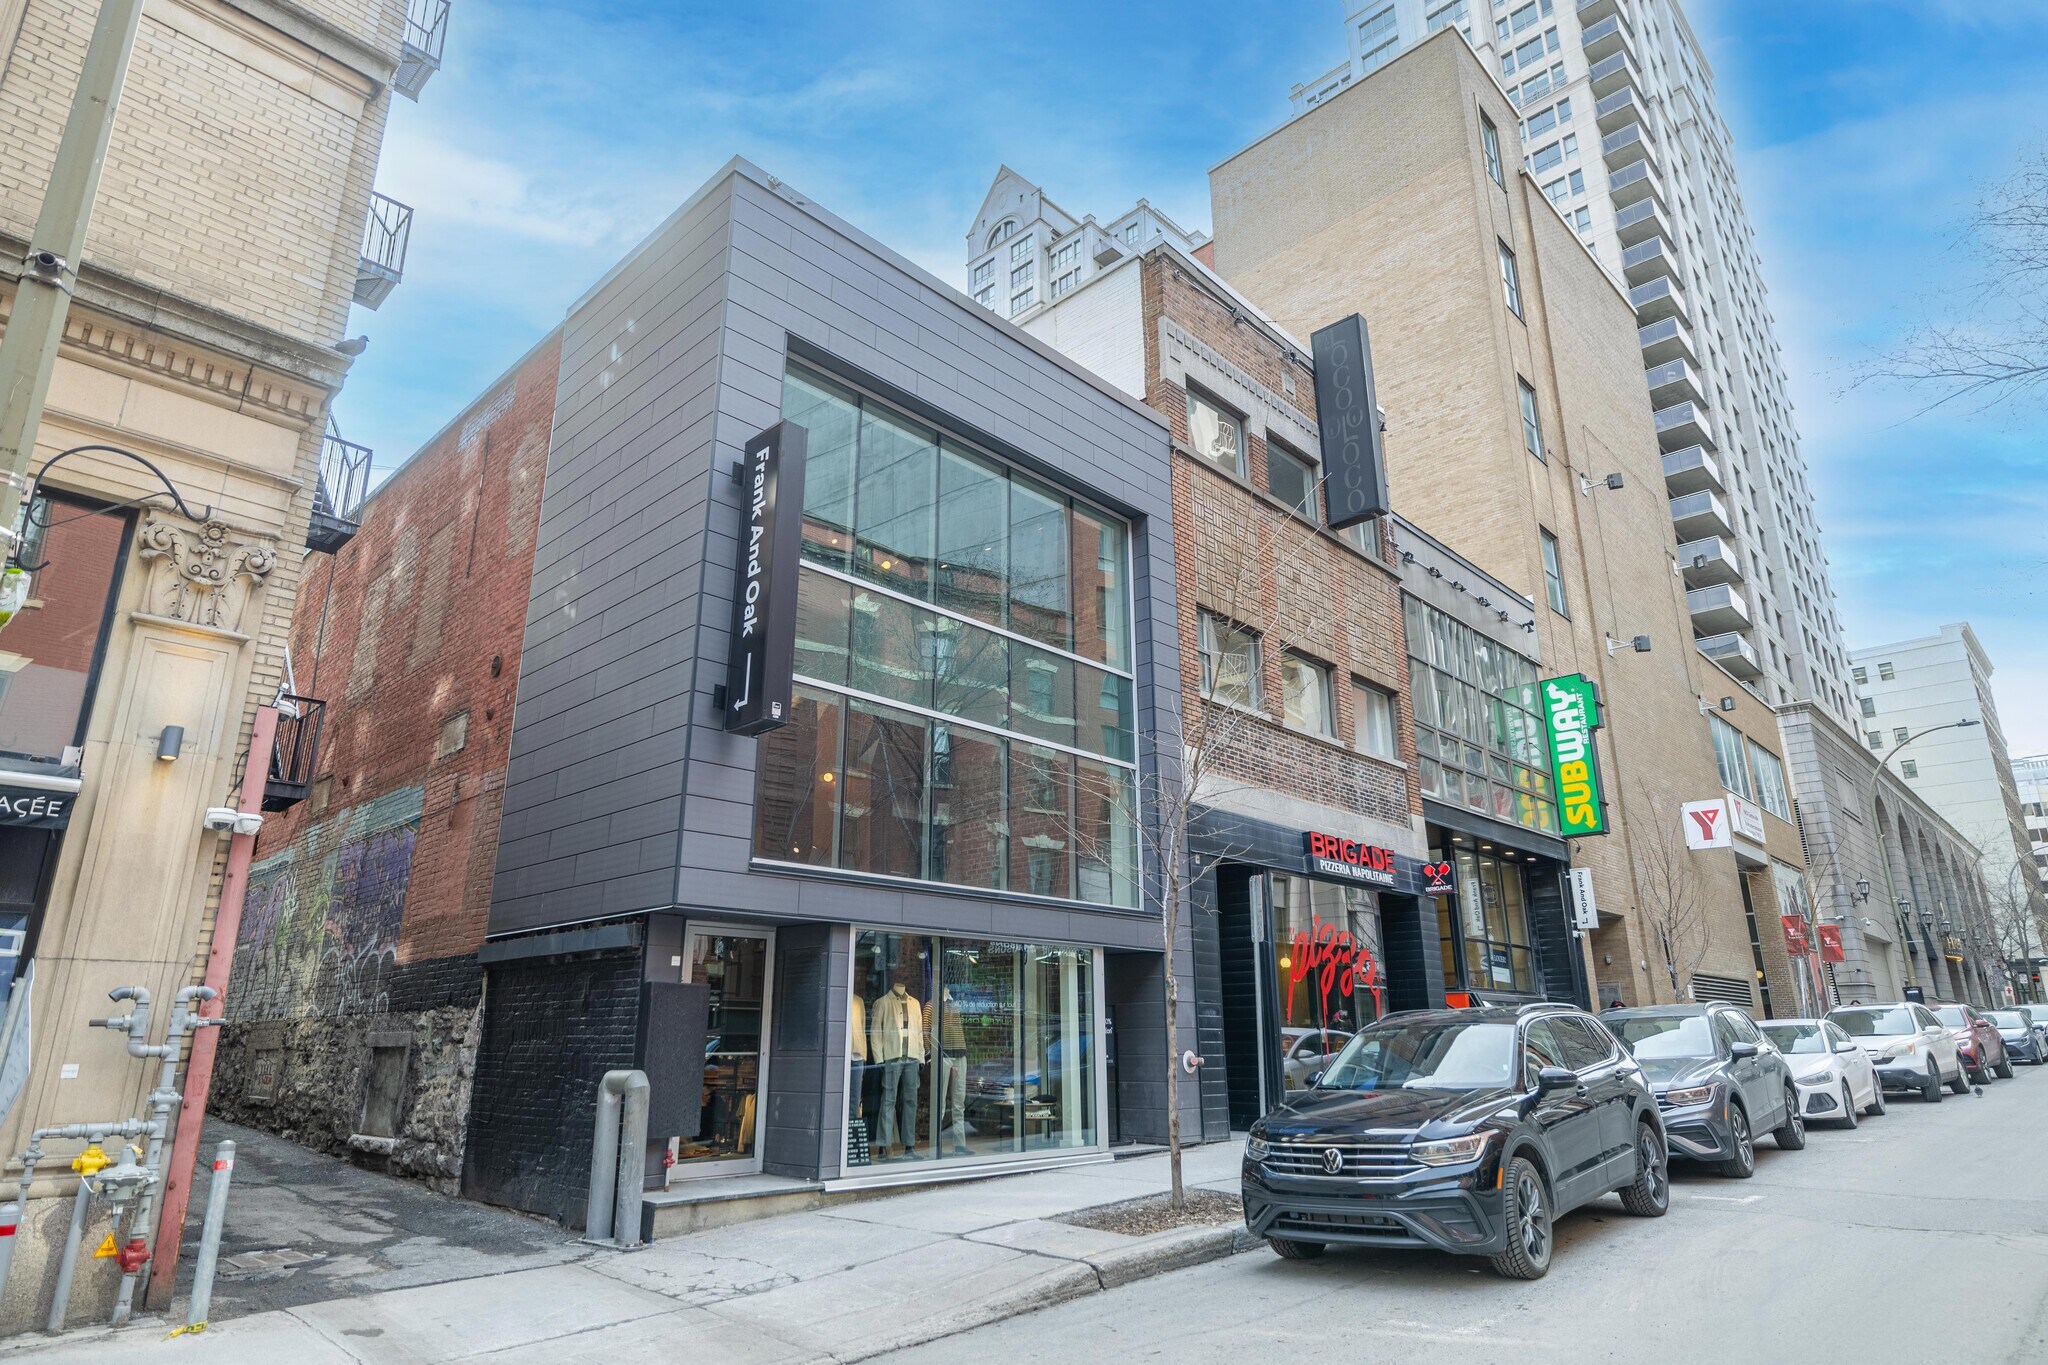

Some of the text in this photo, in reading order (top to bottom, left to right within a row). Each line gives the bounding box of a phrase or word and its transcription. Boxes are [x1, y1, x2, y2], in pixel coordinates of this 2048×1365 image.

[742, 446, 770, 638] Frank And Oak
[1576, 692, 1590, 745] RESTAURANT
[1546, 682, 1598, 830] SUBWAY
[1309, 831, 1397, 873] BRIGADE
[1320, 859, 1395, 885] PIZZERIA NAPOLITAINE
[1425, 884, 1453, 893] BRIGADE
[1577, 871, 1589, 915] Frank And Oak
[1287, 914, 1382, 1028] pizza
